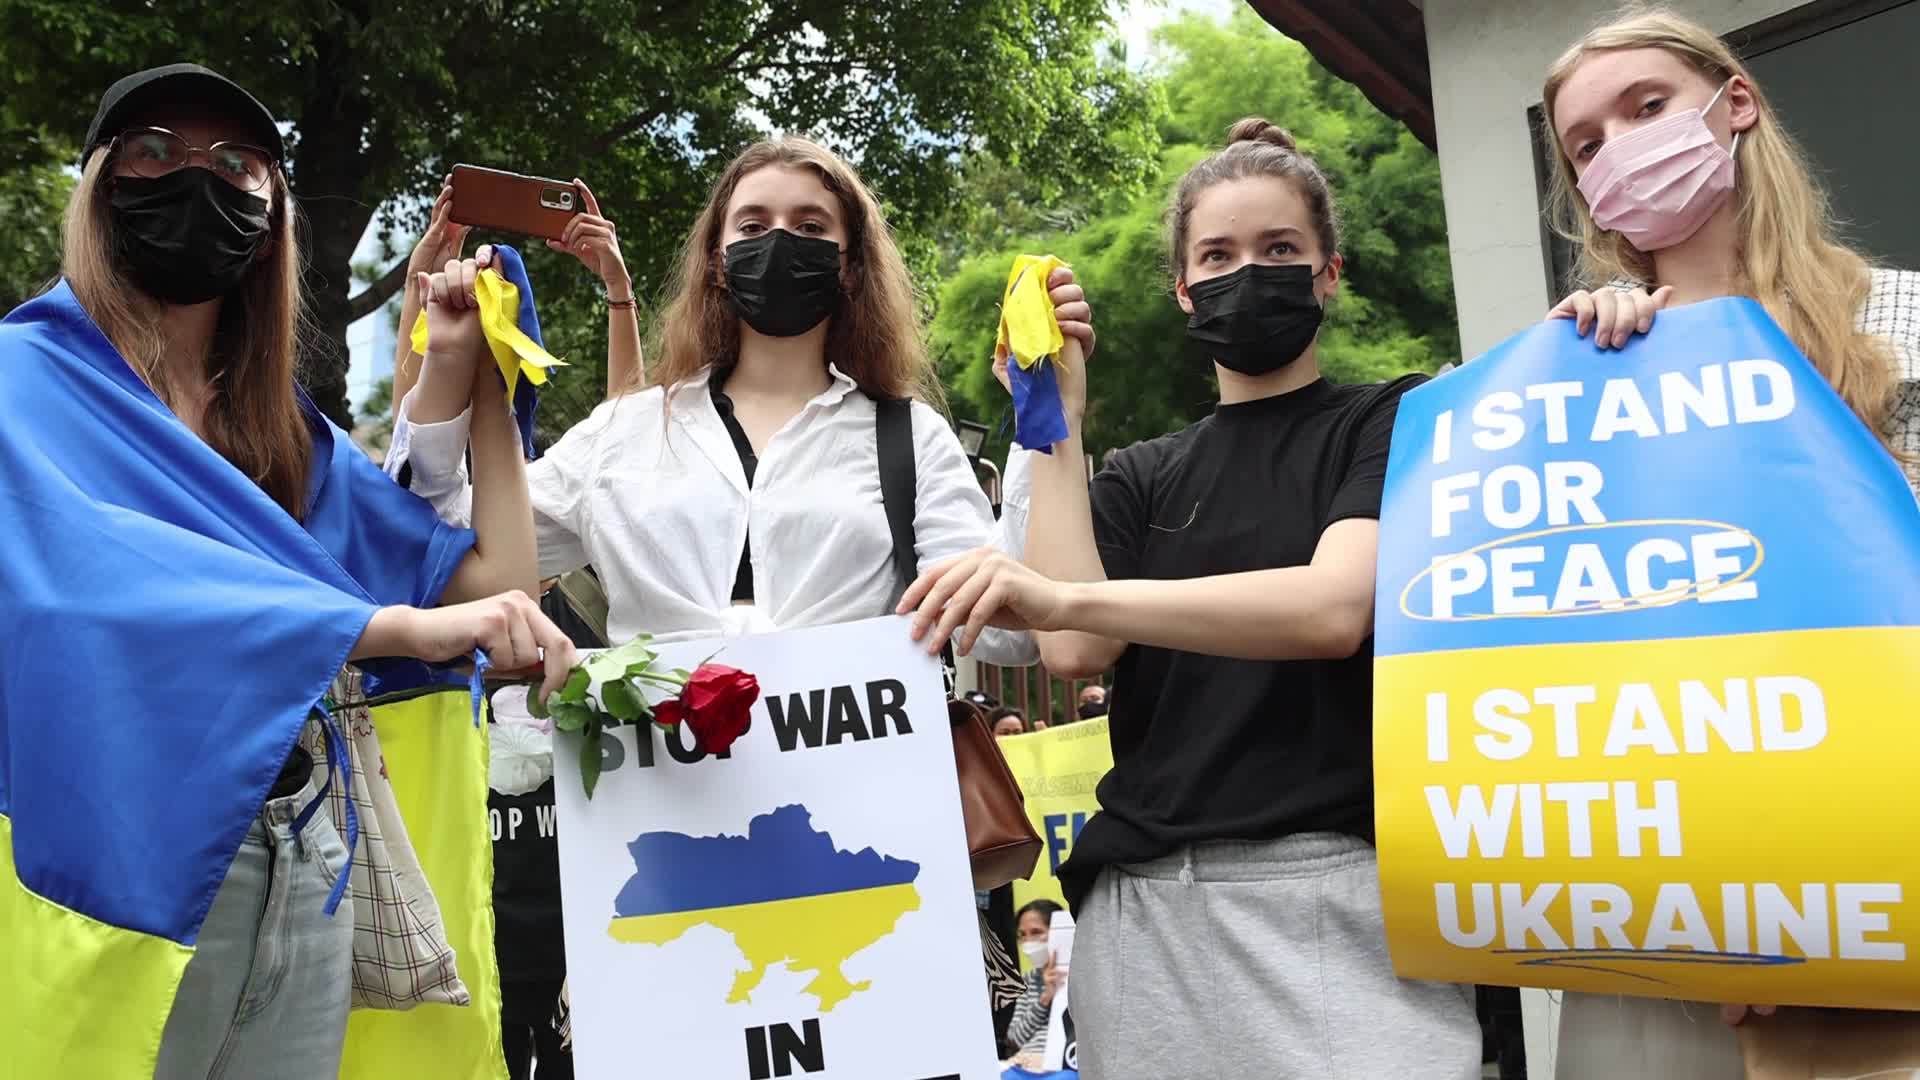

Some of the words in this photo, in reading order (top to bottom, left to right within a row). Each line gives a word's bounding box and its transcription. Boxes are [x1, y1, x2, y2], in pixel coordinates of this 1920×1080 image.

[1432, 410, 1453, 465] I
[1471, 358, 1796, 451] STAND
[1431, 461, 1607, 538] FOR
[1431, 530, 1759, 620] PEACE
[590, 705, 752, 773] STO
[765, 678, 914, 753] WAR
[1425, 692, 1449, 762] I
[1472, 675, 1828, 761] STAND
[1424, 780, 1683, 859] WITH
[1434, 882, 1906, 961] UKRAINE
[744, 1017, 826, 1080] IN
